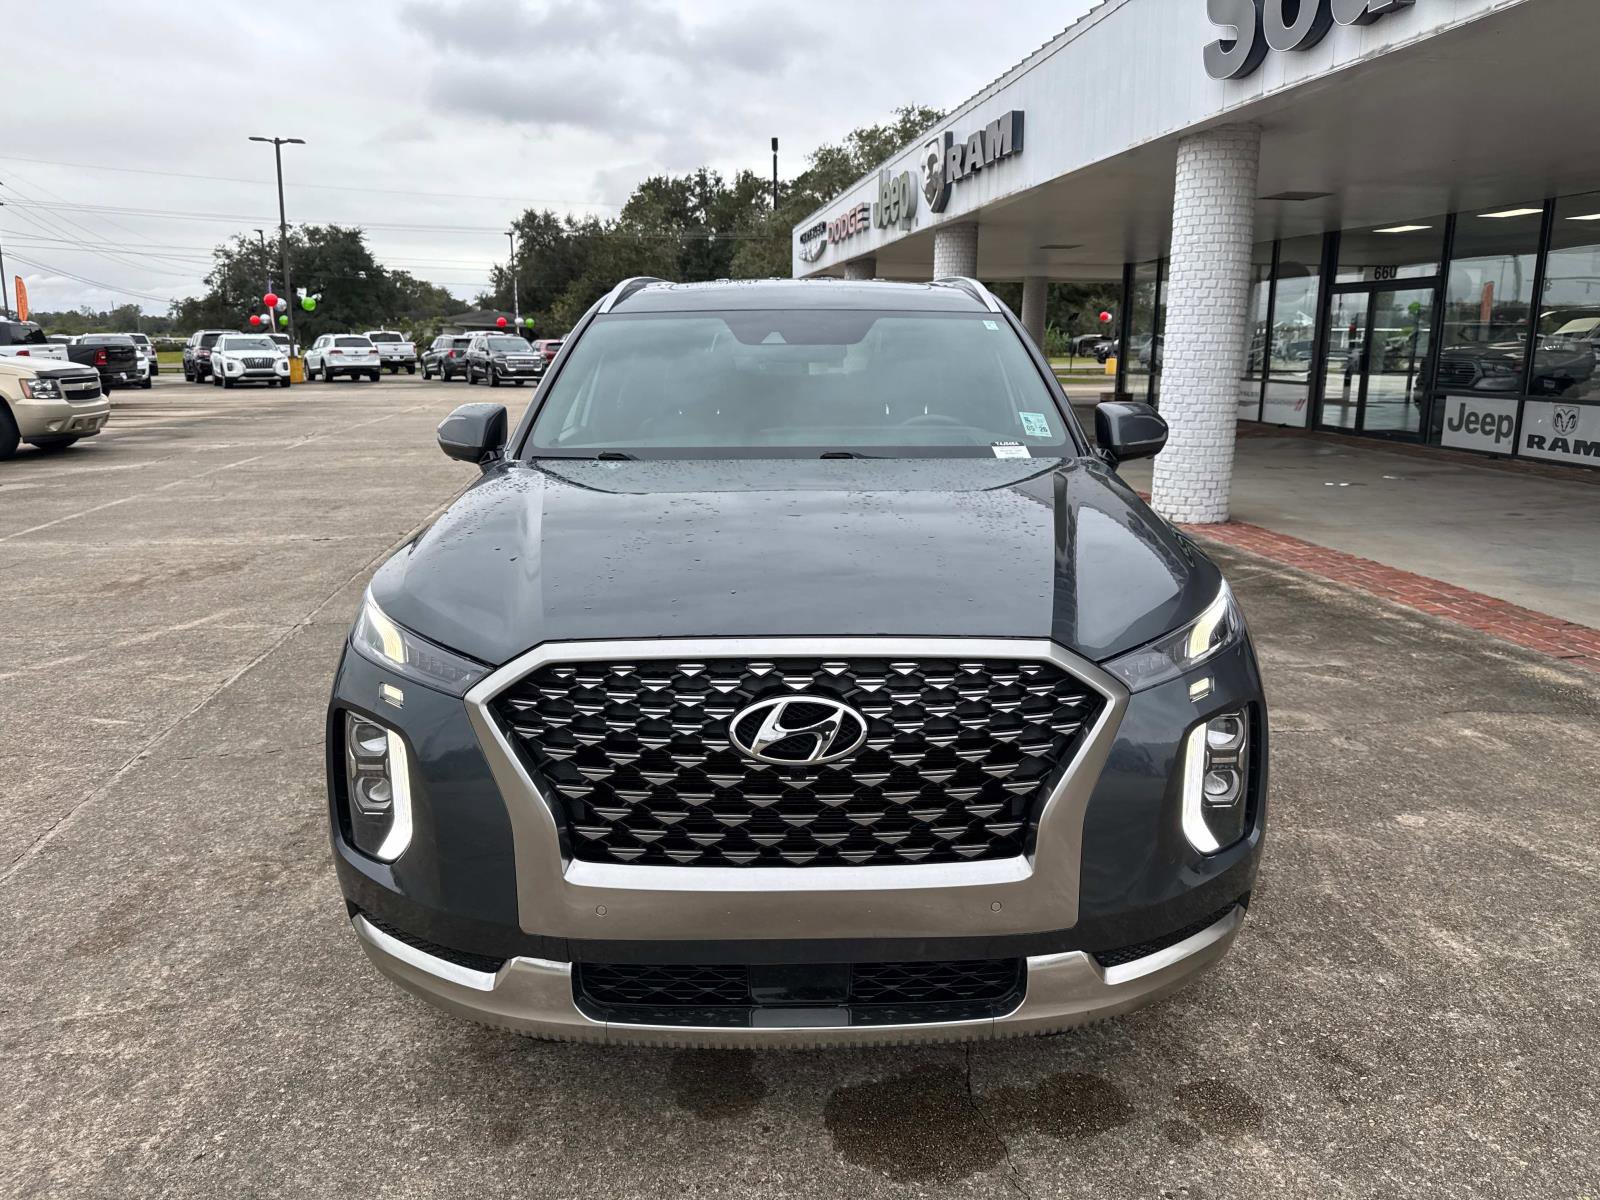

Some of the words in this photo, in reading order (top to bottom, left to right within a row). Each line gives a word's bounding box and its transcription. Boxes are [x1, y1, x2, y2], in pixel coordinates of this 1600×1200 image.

[946, 110, 1020, 184] RAM
[873, 168, 914, 231] Jeep
[827, 202, 868, 245] DODGE
[1447, 402, 1514, 444] Jeep
[1526, 434, 1600, 458] RAM
